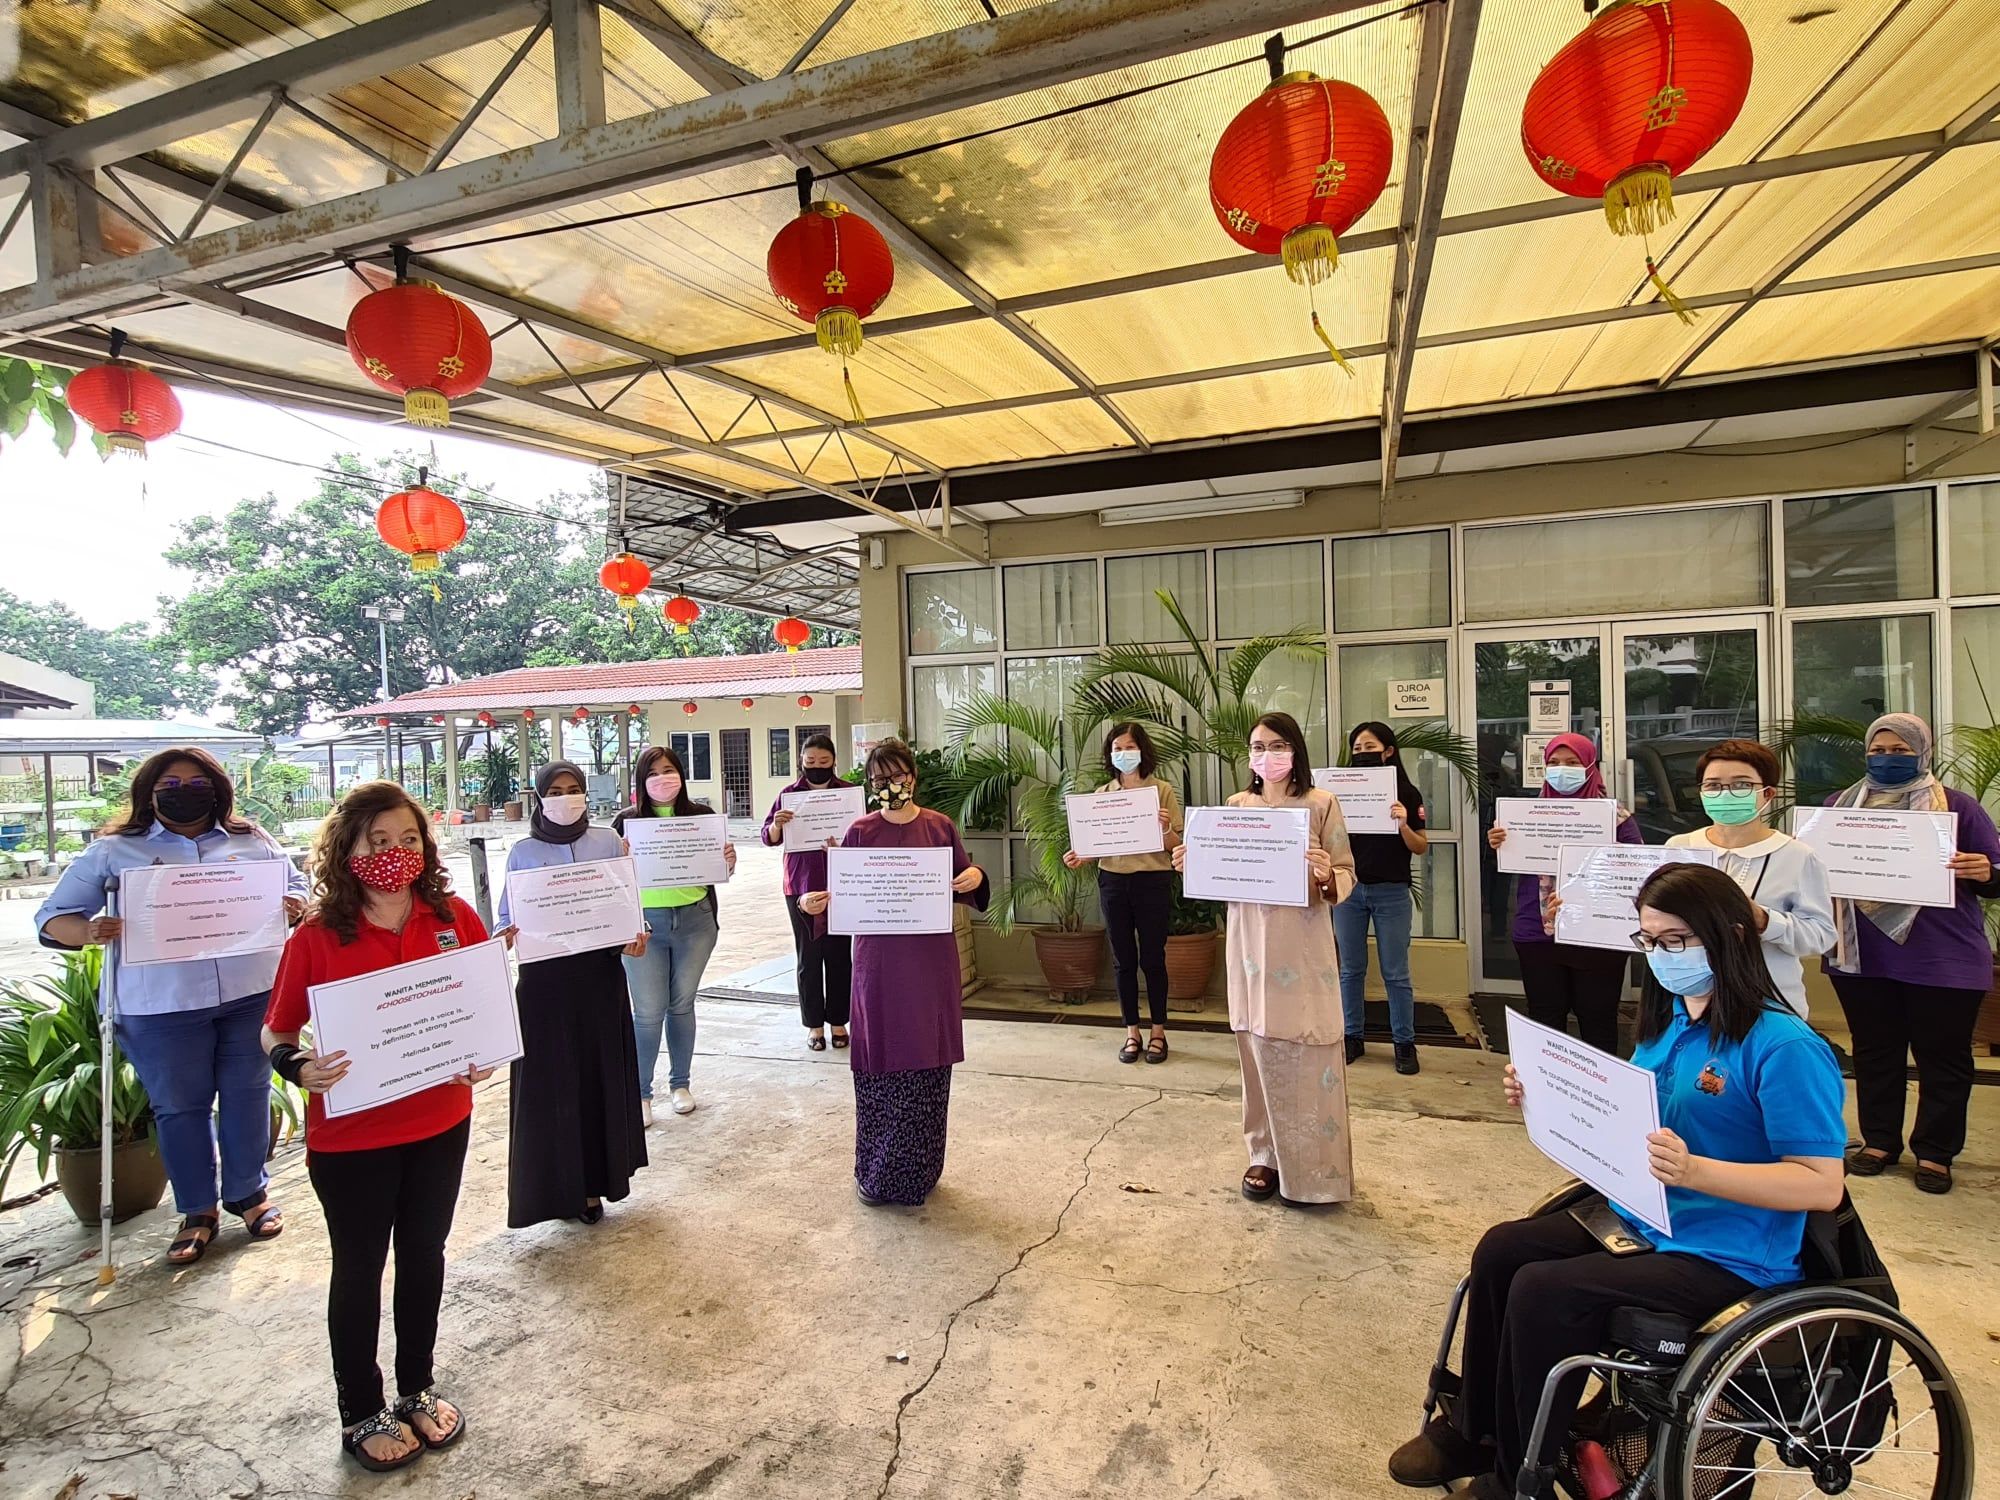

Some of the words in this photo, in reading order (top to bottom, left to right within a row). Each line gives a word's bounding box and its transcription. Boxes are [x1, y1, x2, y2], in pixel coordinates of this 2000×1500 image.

[1397, 684, 1431, 693] DJROA
[1401, 694, 1427, 703] Office
[376, 980, 464, 1011] #CHOOSETOCHALLENGE
[384, 986, 414, 998] WANITA
[415, 975, 452, 990] MEMIMPIN
[382, 1023, 412, 1035] "Woman
[413, 1018, 429, 1026] with
[436, 1011, 454, 1019] voice
[382, 1032, 417, 1046] definition,
[425, 1022, 448, 1032] strong
[449, 1012, 476, 1025] woman"
[400, 1046, 430, 1059] -Melinda
[432, 1040, 454, 1049] Gates-
[1546, 1040, 1568, 1054] WANITA
[1569, 1050, 1598, 1068] MEMIMPIN
[379, 1070, 423, 1088] -INTERNATIONAL
[424, 1061, 450, 1072] WOMEN'S
[1542, 1048, 1608, 1084] #CHOOSETOCHALLENGE
[1548, 1072, 1581, 1092] courageous
[1582, 1088, 1593, 1098] and
[1593, 1094, 1610, 1107] stand
[1611, 1103, 1619, 1112] up
[1556, 1086, 1569, 1096] what
[1570, 1093, 1580, 1102] you
[1581, 1097, 1601, 1113] believe
[1658, 1340, 1686, 1355] ROHO
